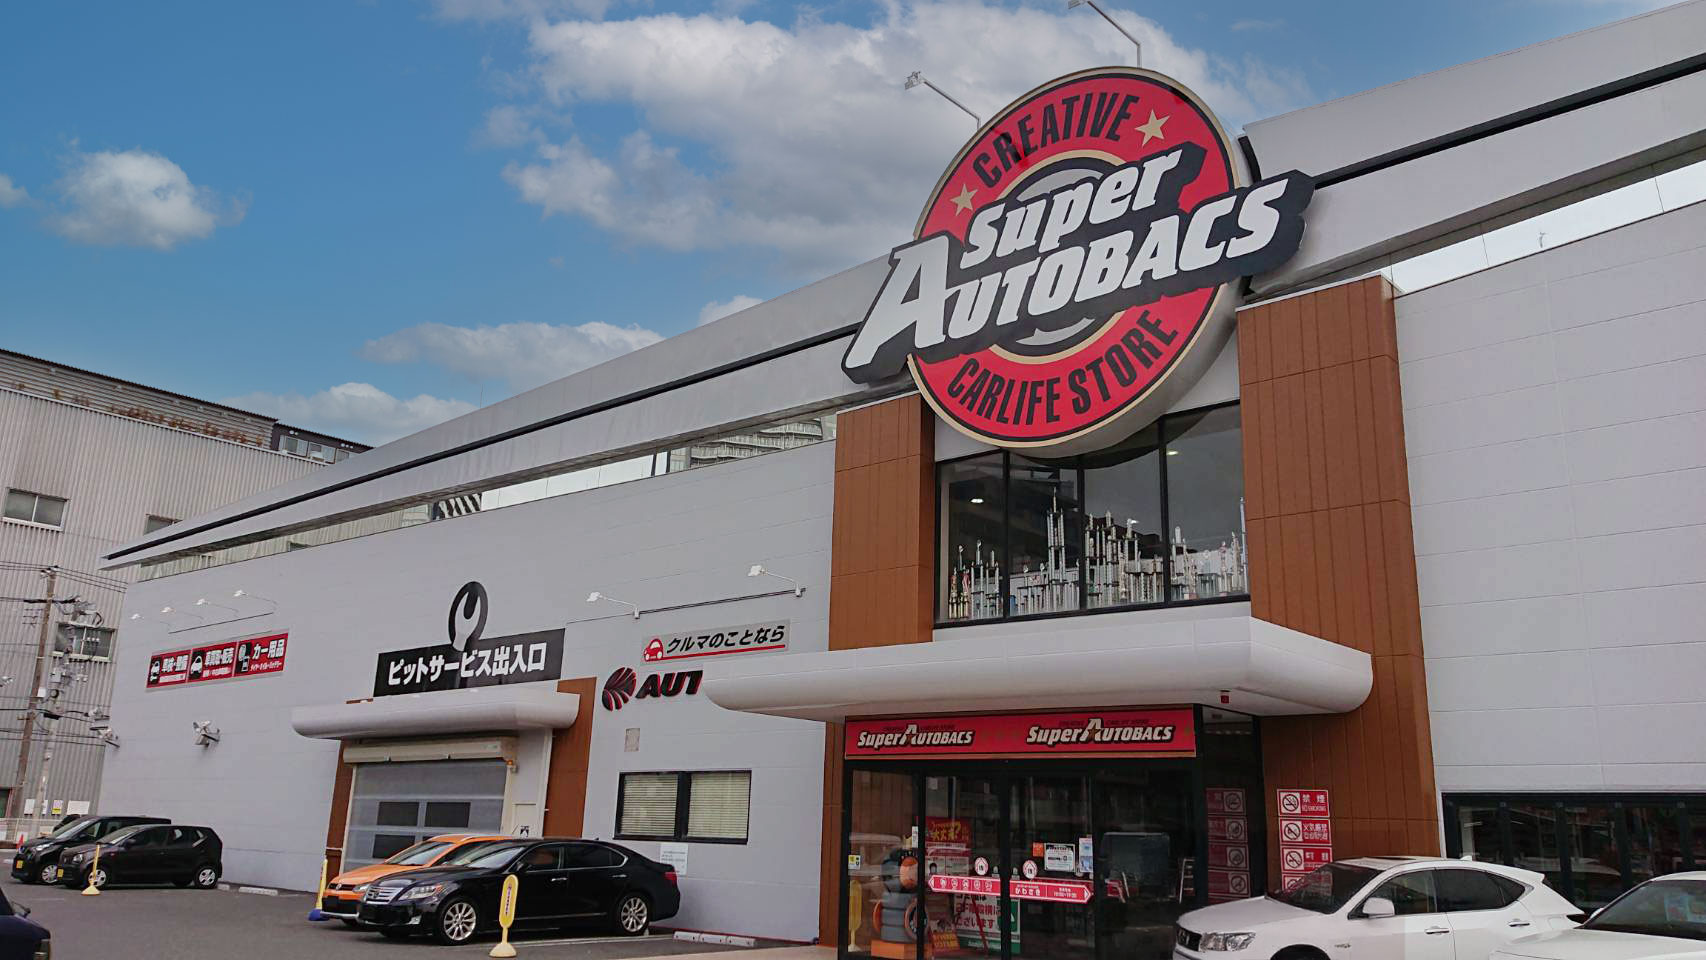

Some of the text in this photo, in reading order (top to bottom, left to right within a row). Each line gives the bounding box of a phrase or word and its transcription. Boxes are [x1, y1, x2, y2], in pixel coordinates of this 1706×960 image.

[972, 91, 1142, 189] CREATIVE
[845, 178, 1290, 370] AUTOBACS
[947, 310, 1179, 426] CARLIFE STORE
[387, 642, 548, 686] ピットサービス出入口
[666, 625, 785, 654] クルマのことなら
